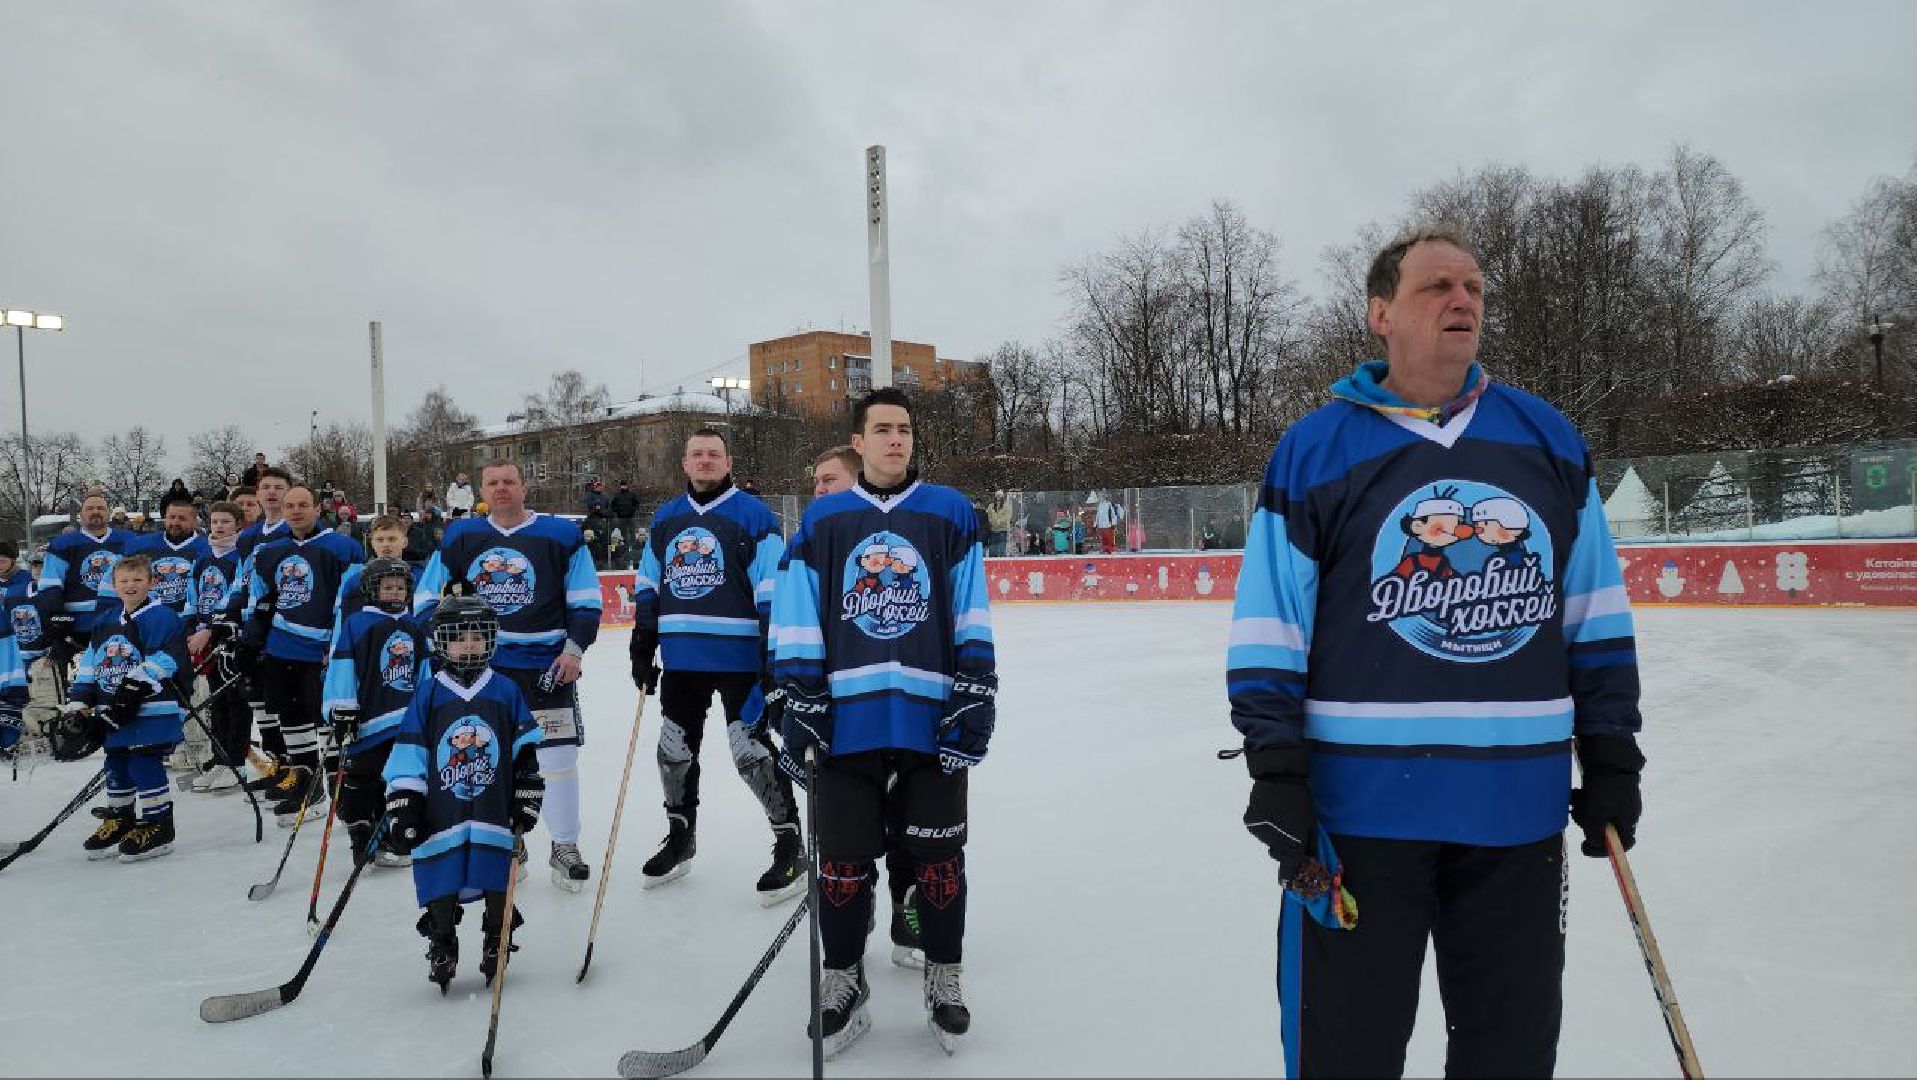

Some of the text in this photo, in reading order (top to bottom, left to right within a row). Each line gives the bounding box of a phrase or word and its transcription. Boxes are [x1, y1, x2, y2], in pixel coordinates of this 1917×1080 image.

[1366, 556, 1543, 622] Дворовый
[1450, 581, 1558, 634] хоккей
[1440, 639, 1503, 653] МЫТИЩИ
